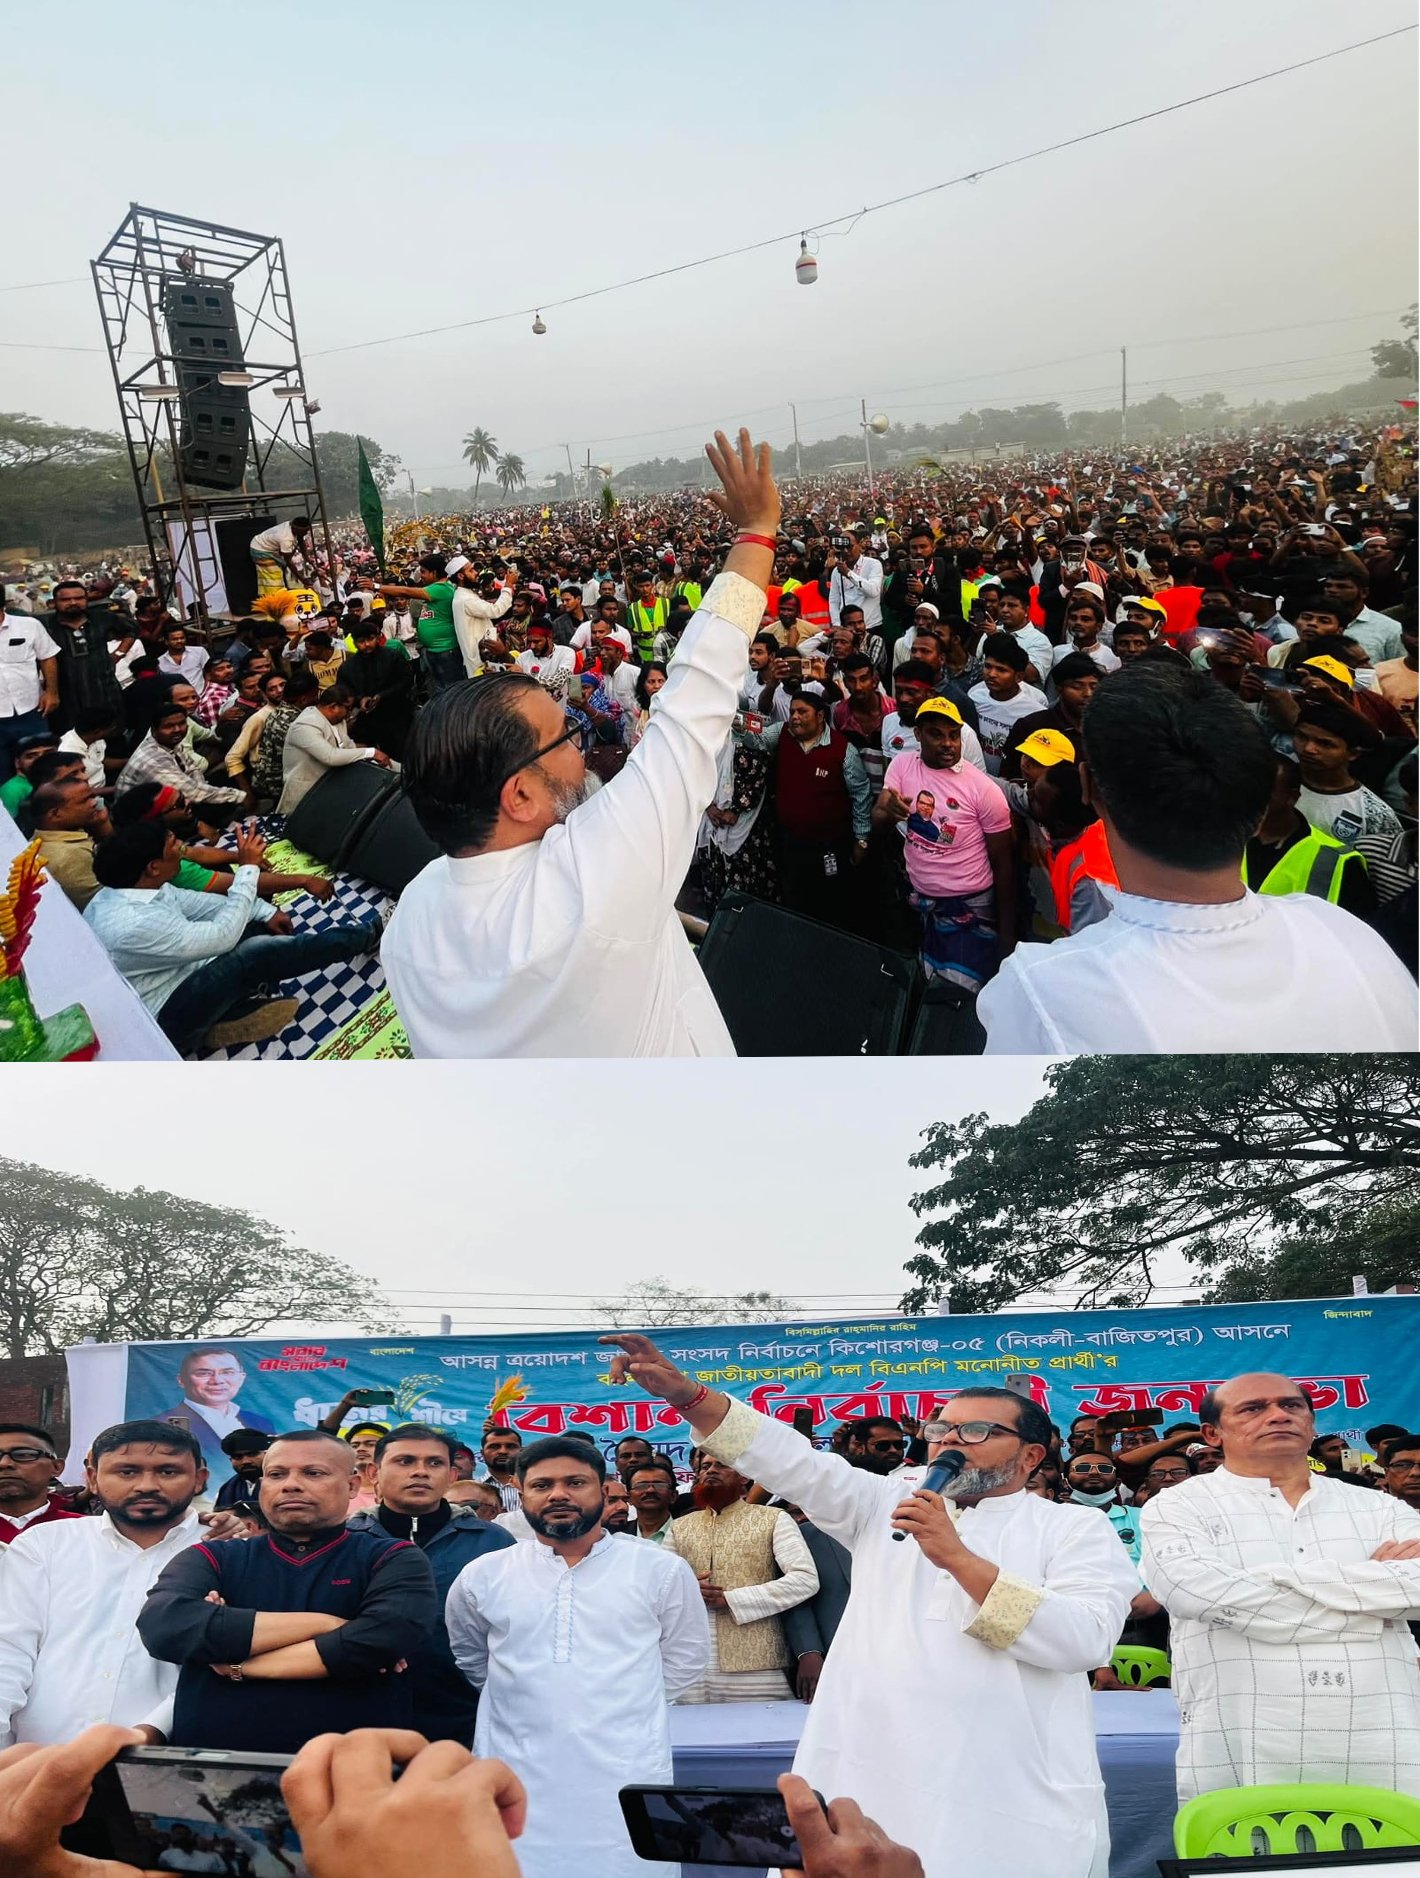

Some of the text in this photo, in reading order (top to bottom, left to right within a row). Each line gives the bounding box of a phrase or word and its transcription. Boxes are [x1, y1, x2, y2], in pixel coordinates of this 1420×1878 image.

[1323, 1309, 1373, 1319] জিন্দাবাদ
[889, 1322, 917, 1332] রাহিম
[369, 1347, 416, 1356] বাংলাদেশ
[439, 1355, 500, 1370] আসন্ন
[506, 1351, 588, 1367] ত্রয়োদশ
[669, 1347, 732, 1362] সংসদ
[737, 1340, 821, 1361] নির্বাচনে
[828, 1337, 985, 1359] কিশোরগঞ্জ-০৫
[996, 1326, 1204, 1353] (নিকলী-বাজিতপুর)
[1211, 1324, 1292, 1341] আসনে
[259, 1358, 348, 1372] বাংলাদেশ
[695, 1362, 824, 1383] জাতীয়তাবাদী
[830, 1363, 863, 1377] দল
[869, 1358, 948, 1376] বিএনপি
[954, 1354, 1043, 1373] মনোনীত
